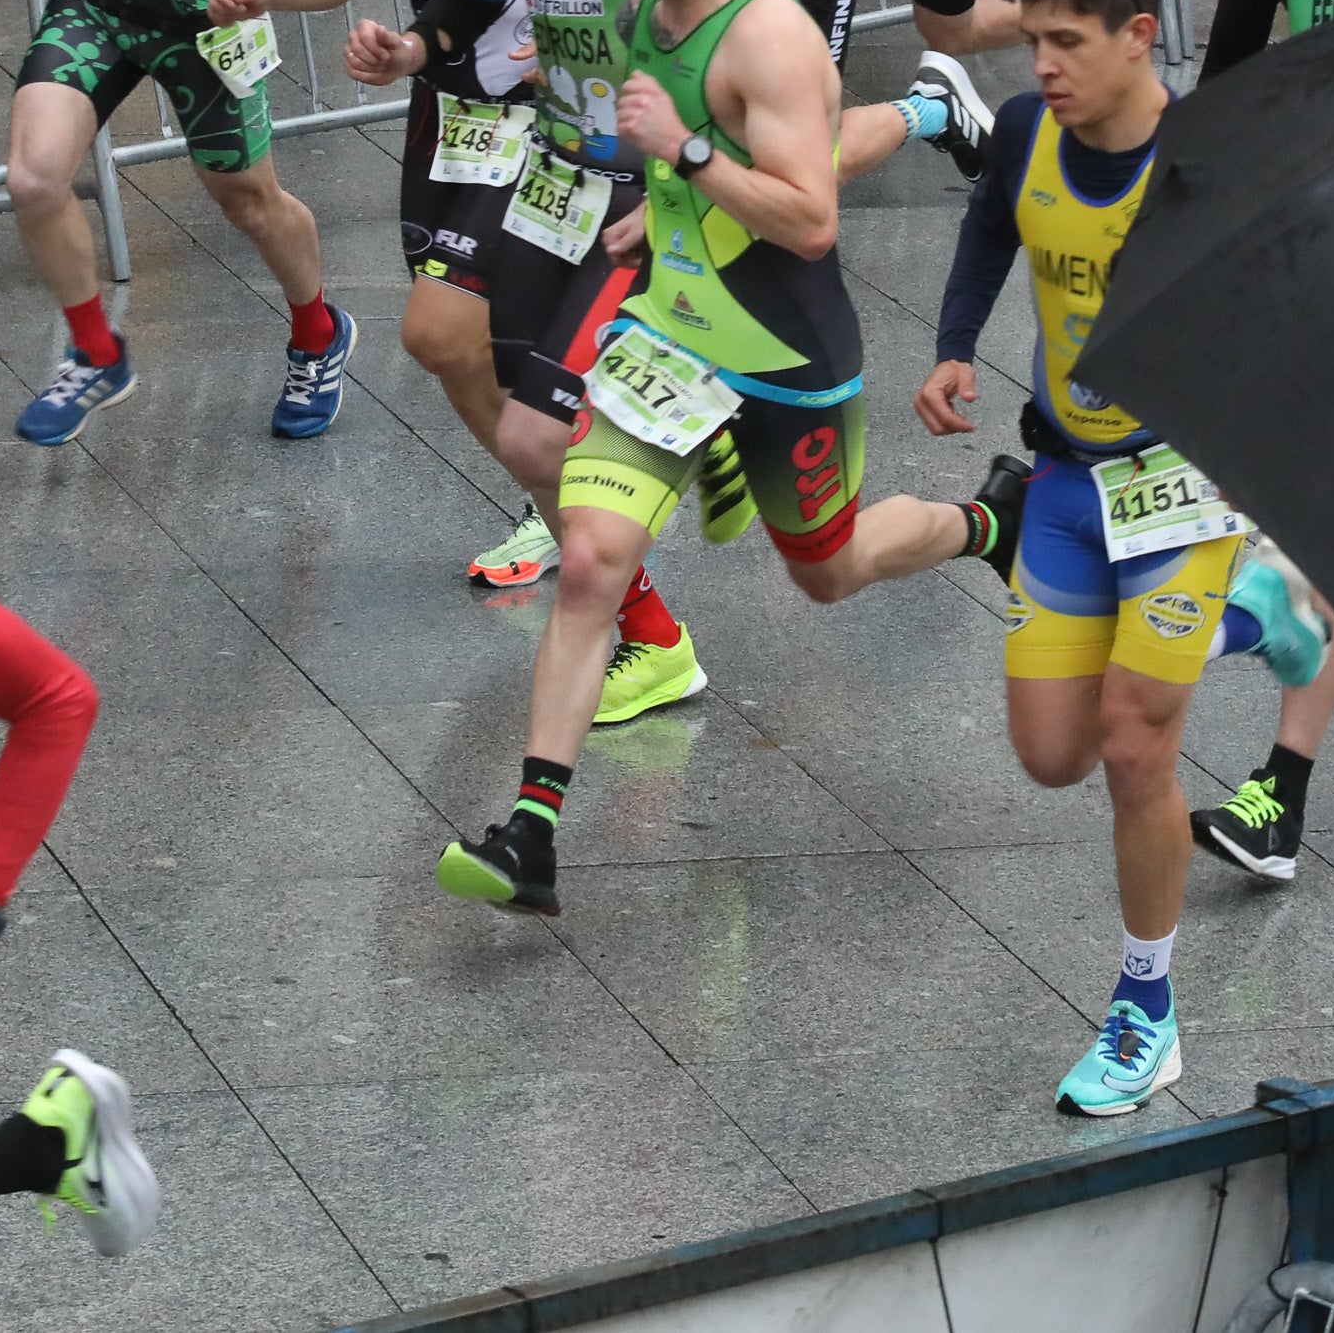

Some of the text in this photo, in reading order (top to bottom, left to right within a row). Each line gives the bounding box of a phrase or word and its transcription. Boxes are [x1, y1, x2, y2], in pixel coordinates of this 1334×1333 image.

[217, 40, 246, 72] 64
[518, 177, 568, 223] 4125
[435, 228, 479, 256] FLR
[602, 352, 676, 411] 4117
[1109, 477, 1197, 524] 4151
